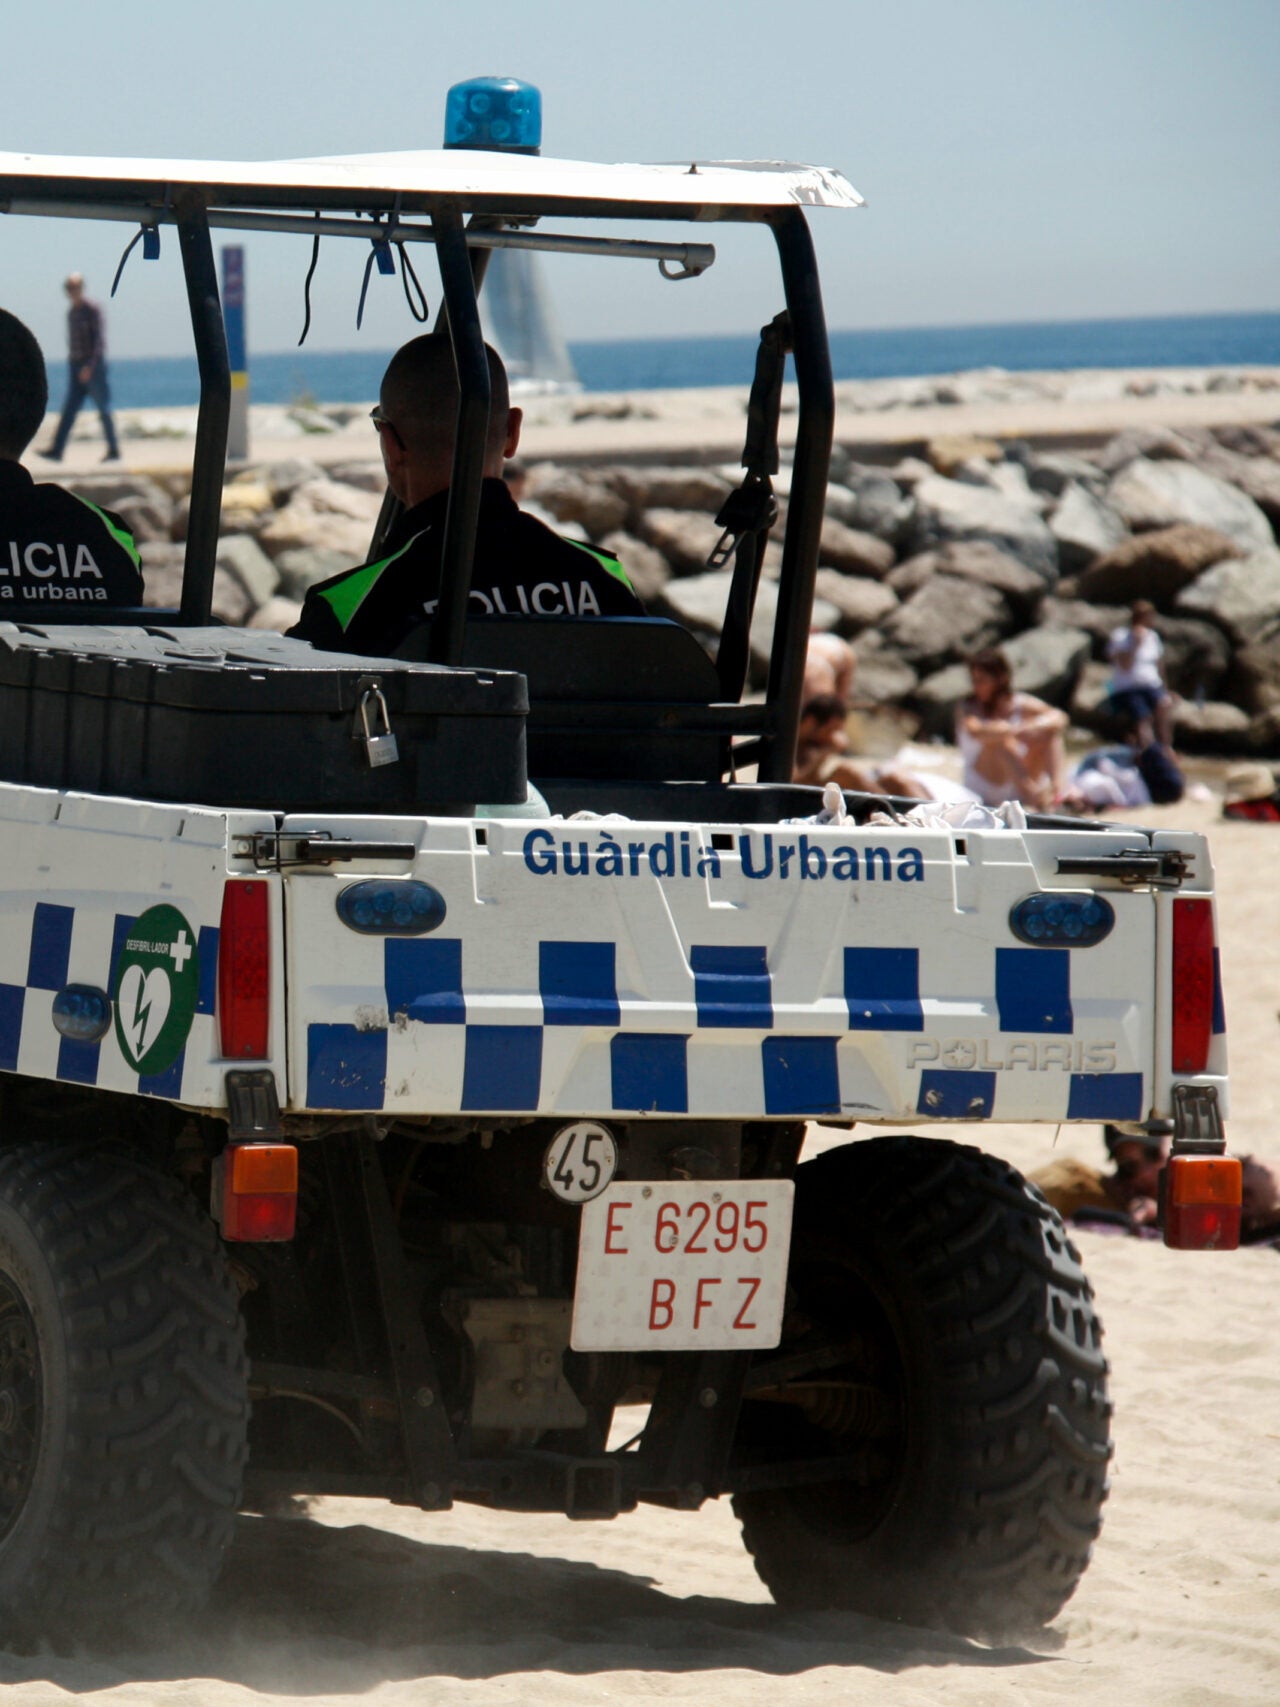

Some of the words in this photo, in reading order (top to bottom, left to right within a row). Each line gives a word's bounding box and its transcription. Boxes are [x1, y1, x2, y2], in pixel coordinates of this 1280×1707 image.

[22, 582, 108, 600] urbana
[522, 828, 721, 878] Guàrdia
[739, 832, 925, 882] Urbana
[906, 1038, 1117, 1072] POLARIS
[553, 1133, 604, 1191] 45
[604, 1202, 632, 1254] E
[654, 1201, 768, 1254] 6295
